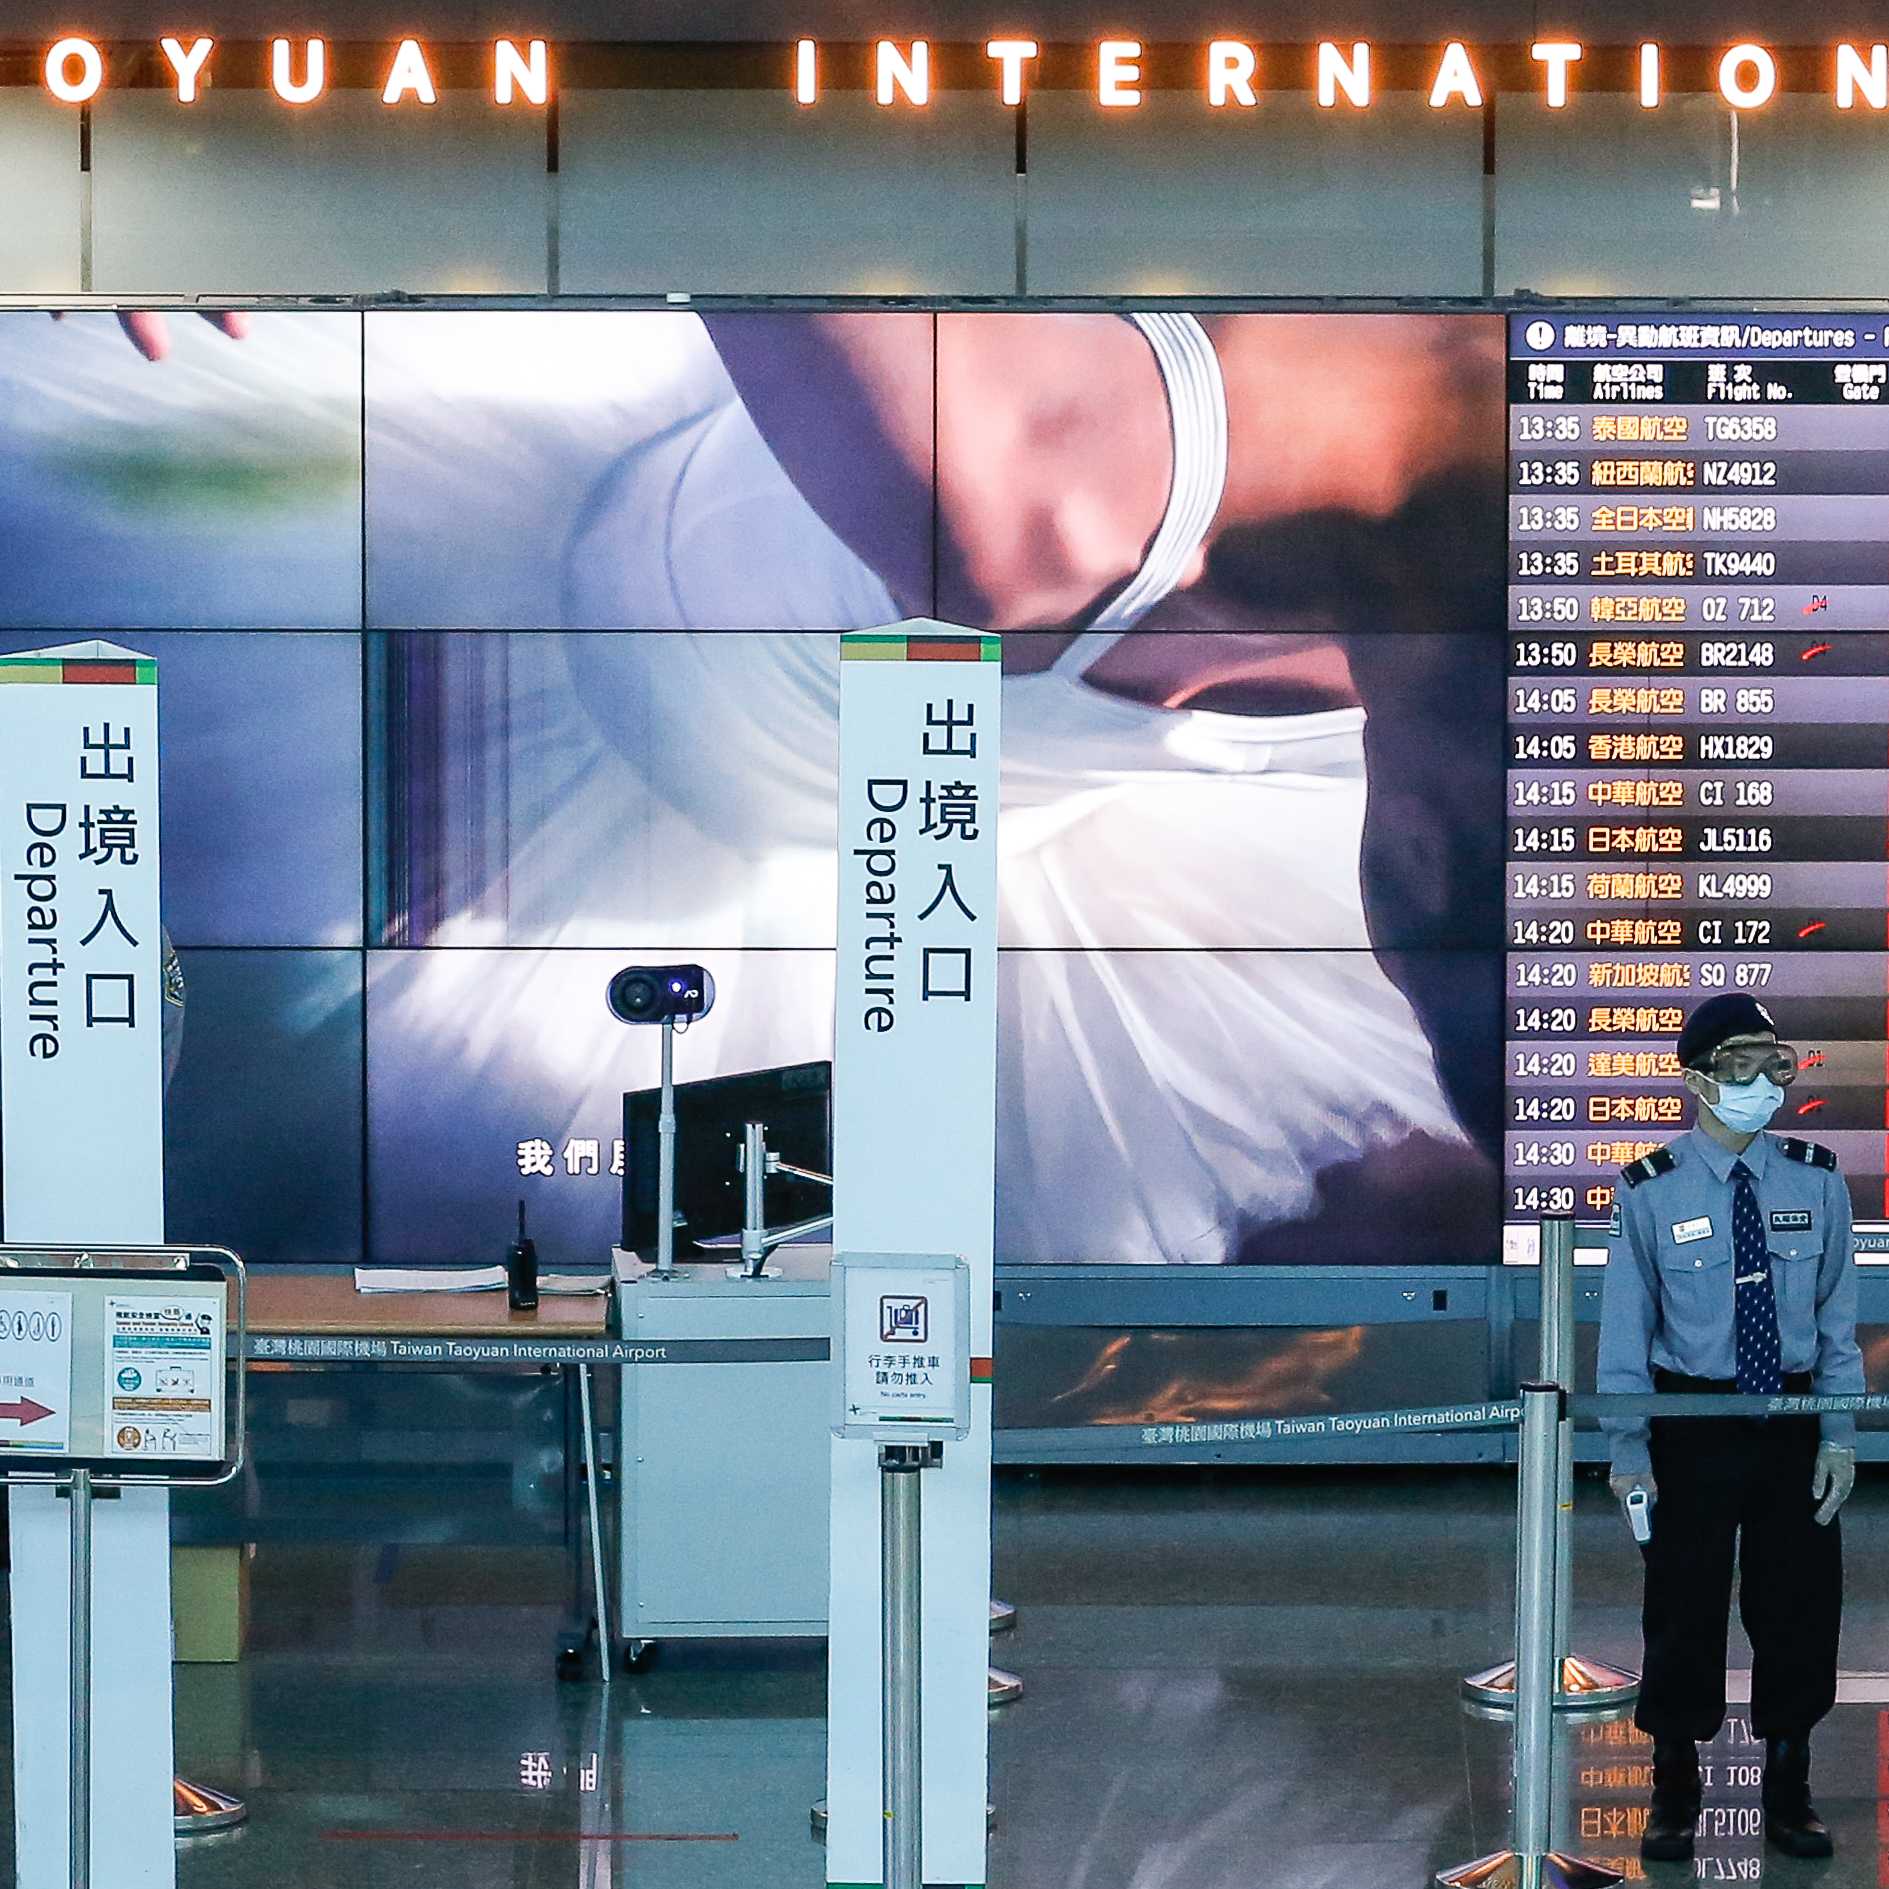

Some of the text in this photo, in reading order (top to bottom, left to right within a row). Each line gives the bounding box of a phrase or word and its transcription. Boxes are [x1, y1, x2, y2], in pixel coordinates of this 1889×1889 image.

[1528, 383, 1563, 400] Time
[1593, 383, 1664, 400] Airlines
[1707, 383, 1763, 401] Flight
[1767, 384, 1793, 400] No.
[1842, 383, 1879, 400] Gate
[1519, 415, 1777, 442] 13:35 泰國航空 TG6358
[1515, 734, 1773, 760] 14:05 香港航空 HX1829
[917, 698, 980, 1003] 出境入口
[1513, 827, 1772, 854] 14:15 日本航空 JL5116
[78, 720, 140, 1030] 出境入口
[853, 778, 908, 1034] Departure
[14, 801, 67, 1061] Departure
[391, 1341, 443, 1358] Taiwan
[447, 1341, 511, 1360] Taoyuan
[514, 1341, 609, 1359] International
[613, 1344, 667, 1362] Airport
